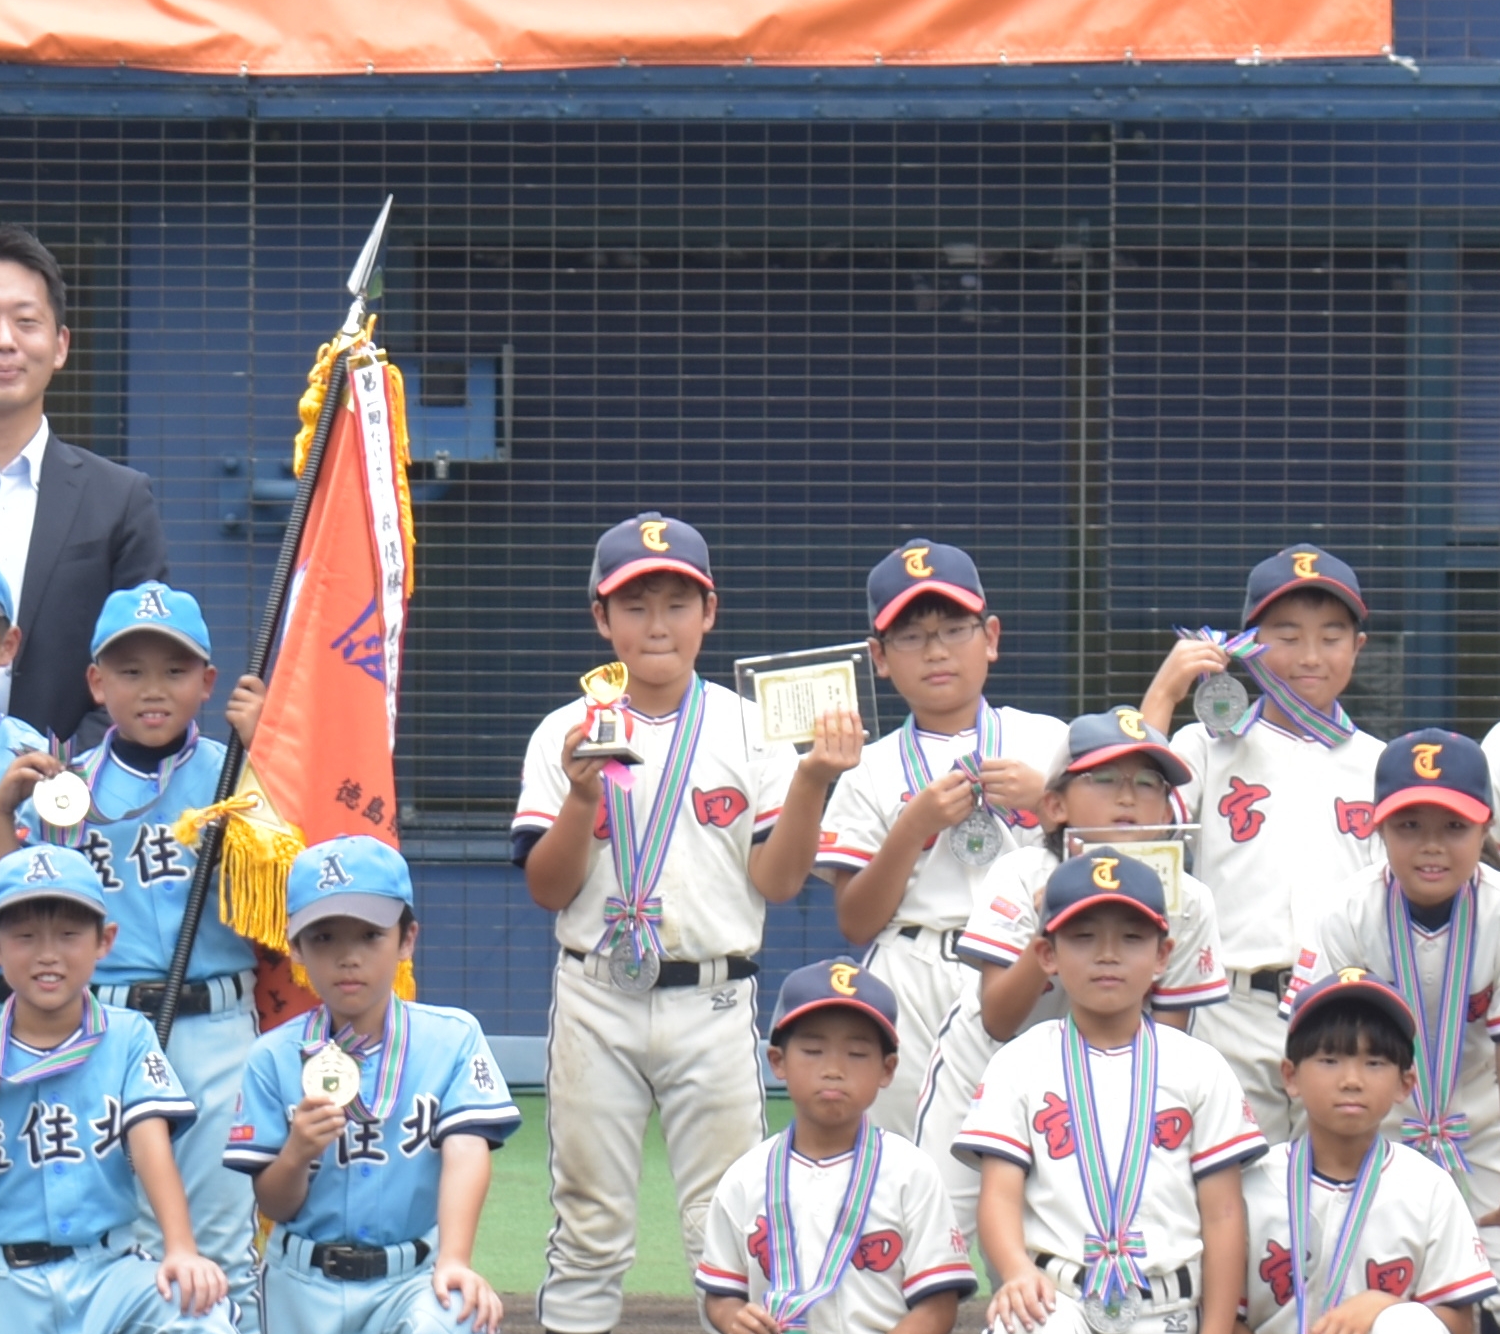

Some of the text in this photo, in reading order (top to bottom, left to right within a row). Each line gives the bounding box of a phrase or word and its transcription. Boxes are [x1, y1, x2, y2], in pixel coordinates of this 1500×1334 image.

[135, 587, 172, 619] A
[24, 851, 62, 884] A
[317, 852, 353, 890] A
